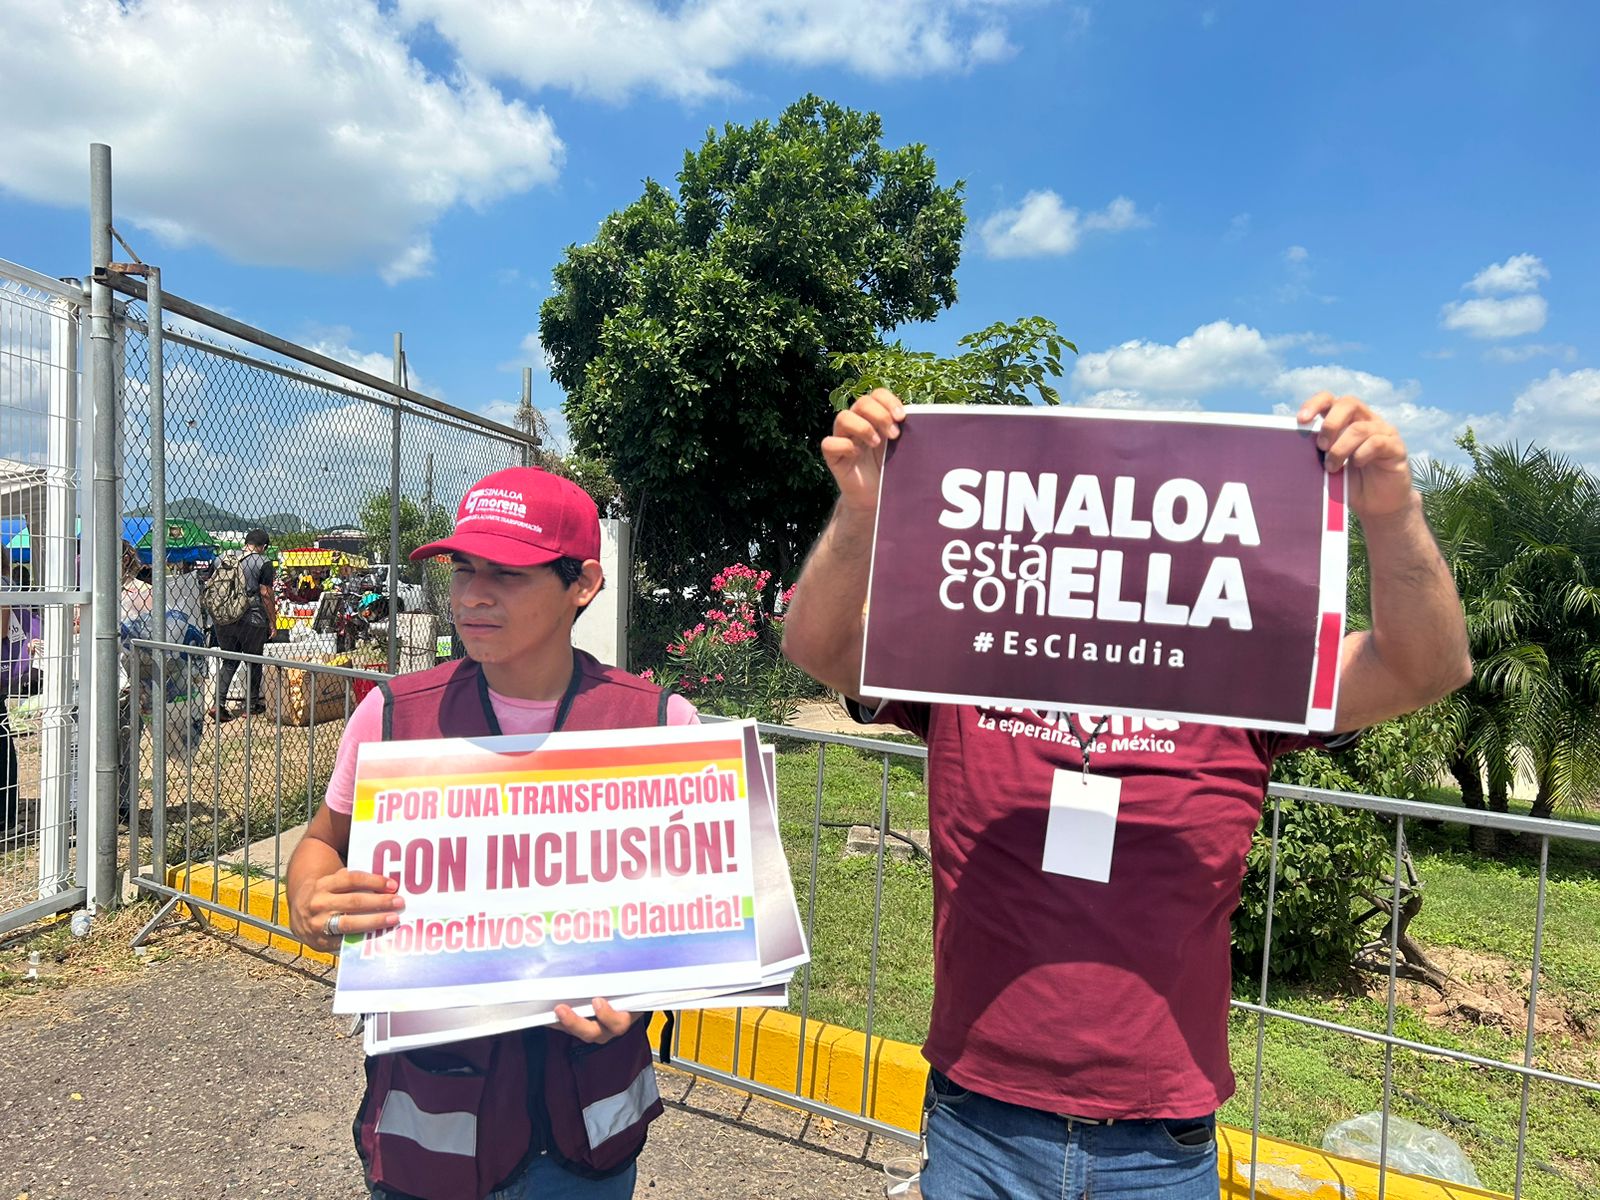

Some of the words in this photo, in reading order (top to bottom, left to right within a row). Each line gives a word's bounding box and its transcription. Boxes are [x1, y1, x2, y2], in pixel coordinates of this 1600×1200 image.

[478, 498, 527, 515] morena
[484, 488, 523, 502] SINALOA
[938, 467, 1261, 546] SINALOA
[941, 531, 1048, 581] está
[939, 574, 1047, 616] con
[1048, 546, 1253, 631] ELLA
[973, 630, 1185, 668] #EsClaudia
[977, 712, 996, 731] La
[999, 717, 1081, 749] esperanza
[1085, 737, 1107, 754] de
[1112, 733, 1176, 754] México
[377, 791, 438, 824] ¡POR
[447, 786, 499, 819] UNA
[508, 768, 736, 816] TRANSFORMACIÓN
[371, 836, 468, 895] CON
[485, 809, 738, 891] INCLUSIÓN!
[553, 908, 611, 942] con
[620, 894, 742, 936] Claudia!
